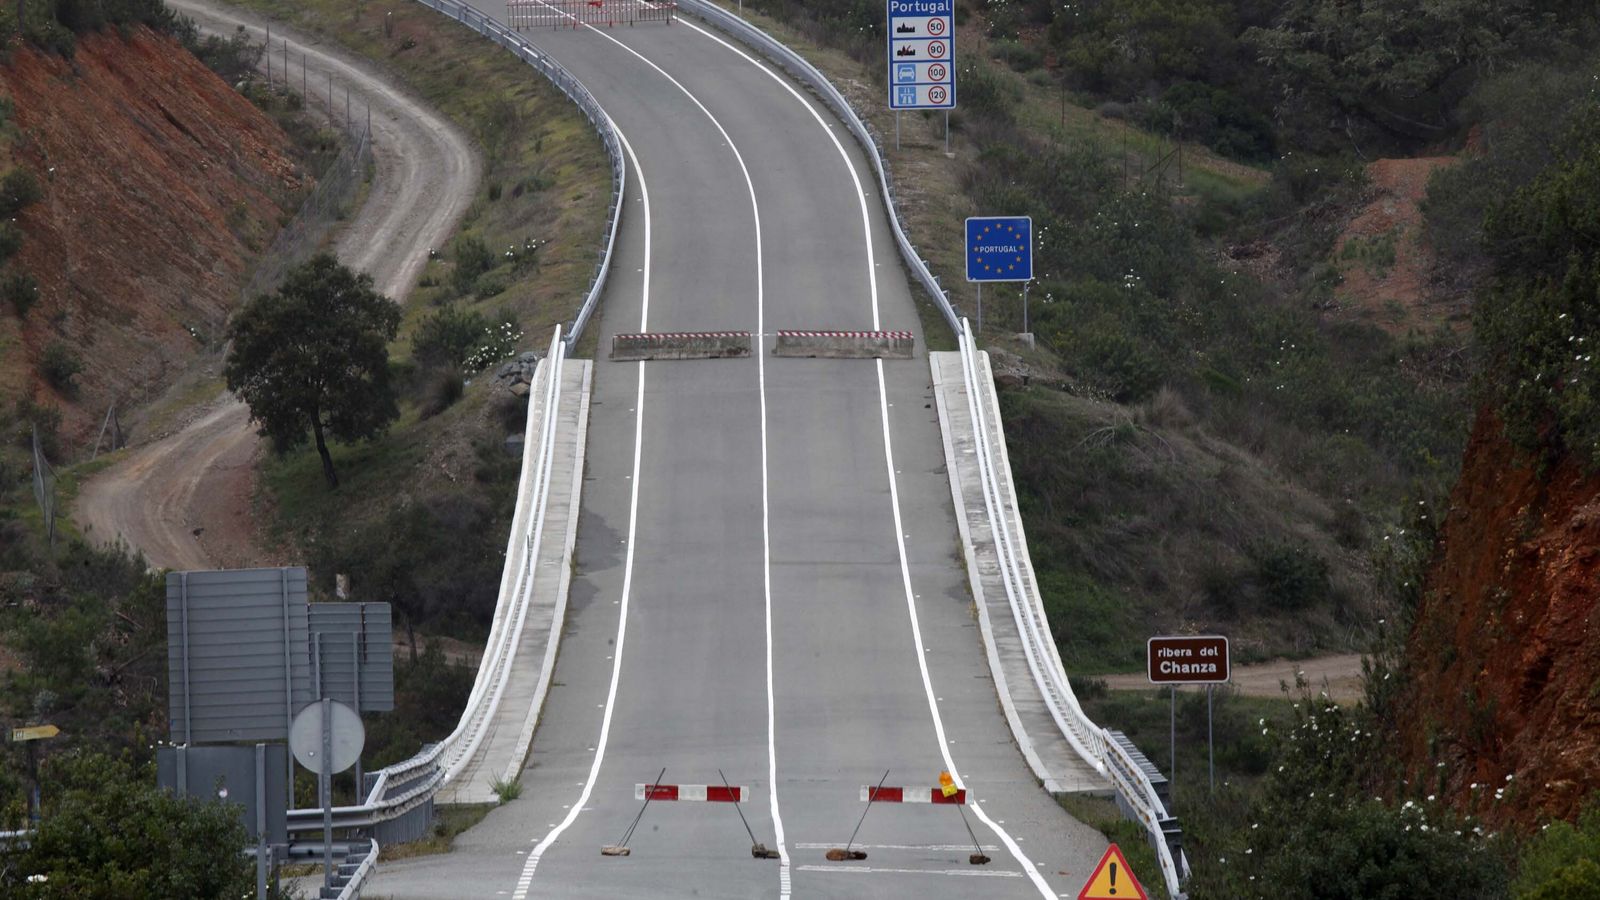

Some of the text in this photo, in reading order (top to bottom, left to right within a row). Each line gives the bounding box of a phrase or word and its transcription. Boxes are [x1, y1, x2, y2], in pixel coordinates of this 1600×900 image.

[891, 0, 950, 13] Portugal
[930, 22, 942, 31] 50
[930, 45, 942, 54] 90
[930, 68, 944, 76] 100
[931, 91, 944, 99] 120
[979, 245, 1018, 253] PORTUGAL
[1158, 646, 1218, 657] ribera del
[1160, 660, 1217, 674] Chanza
